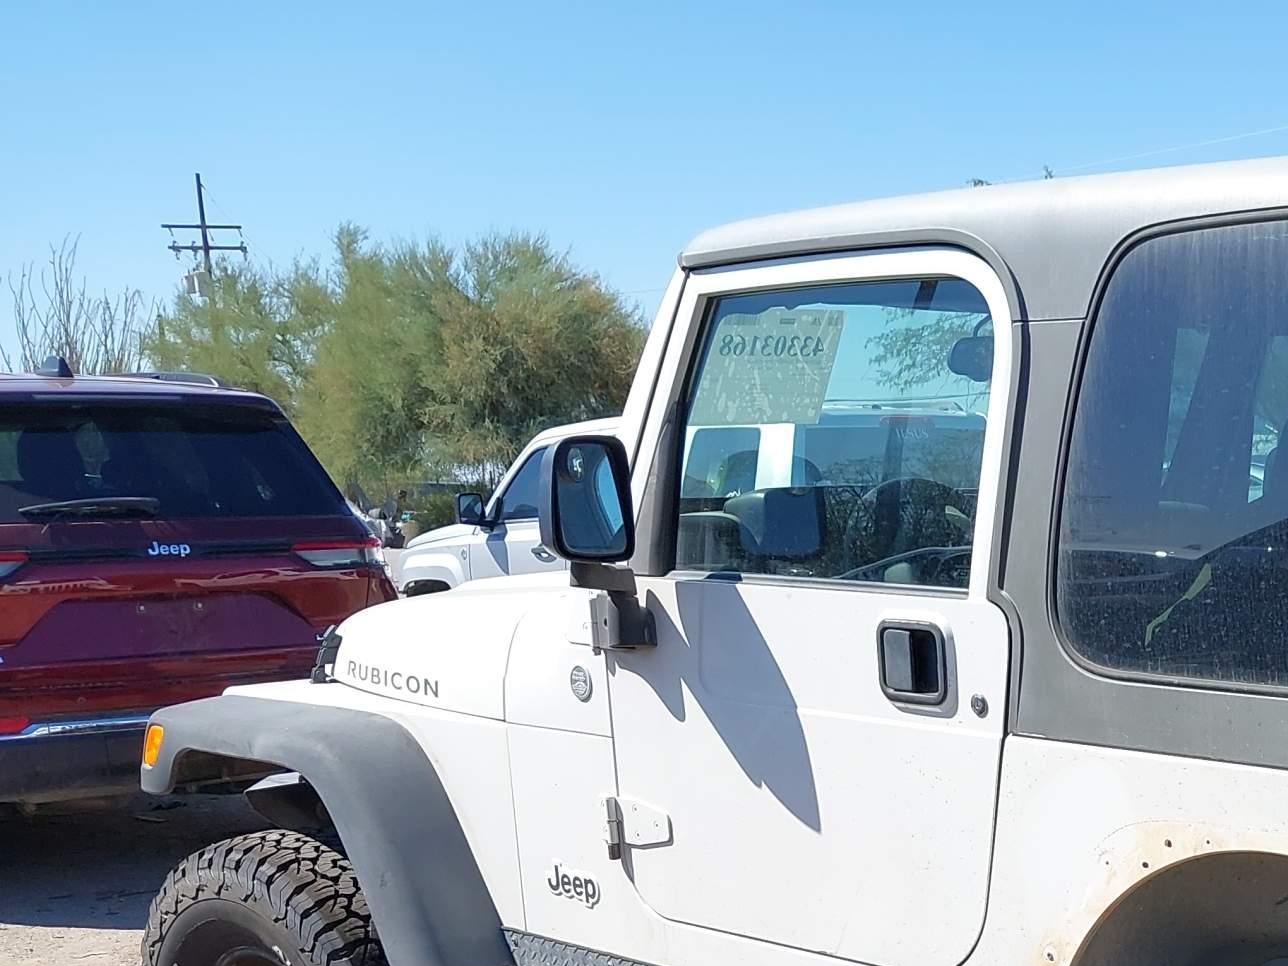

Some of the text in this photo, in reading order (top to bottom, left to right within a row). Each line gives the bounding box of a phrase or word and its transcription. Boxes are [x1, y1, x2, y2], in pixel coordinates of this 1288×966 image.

[148, 541, 191, 558] Jeep
[347, 660, 440, 698] RUBICON
[547, 863, 599, 905] Jeep
